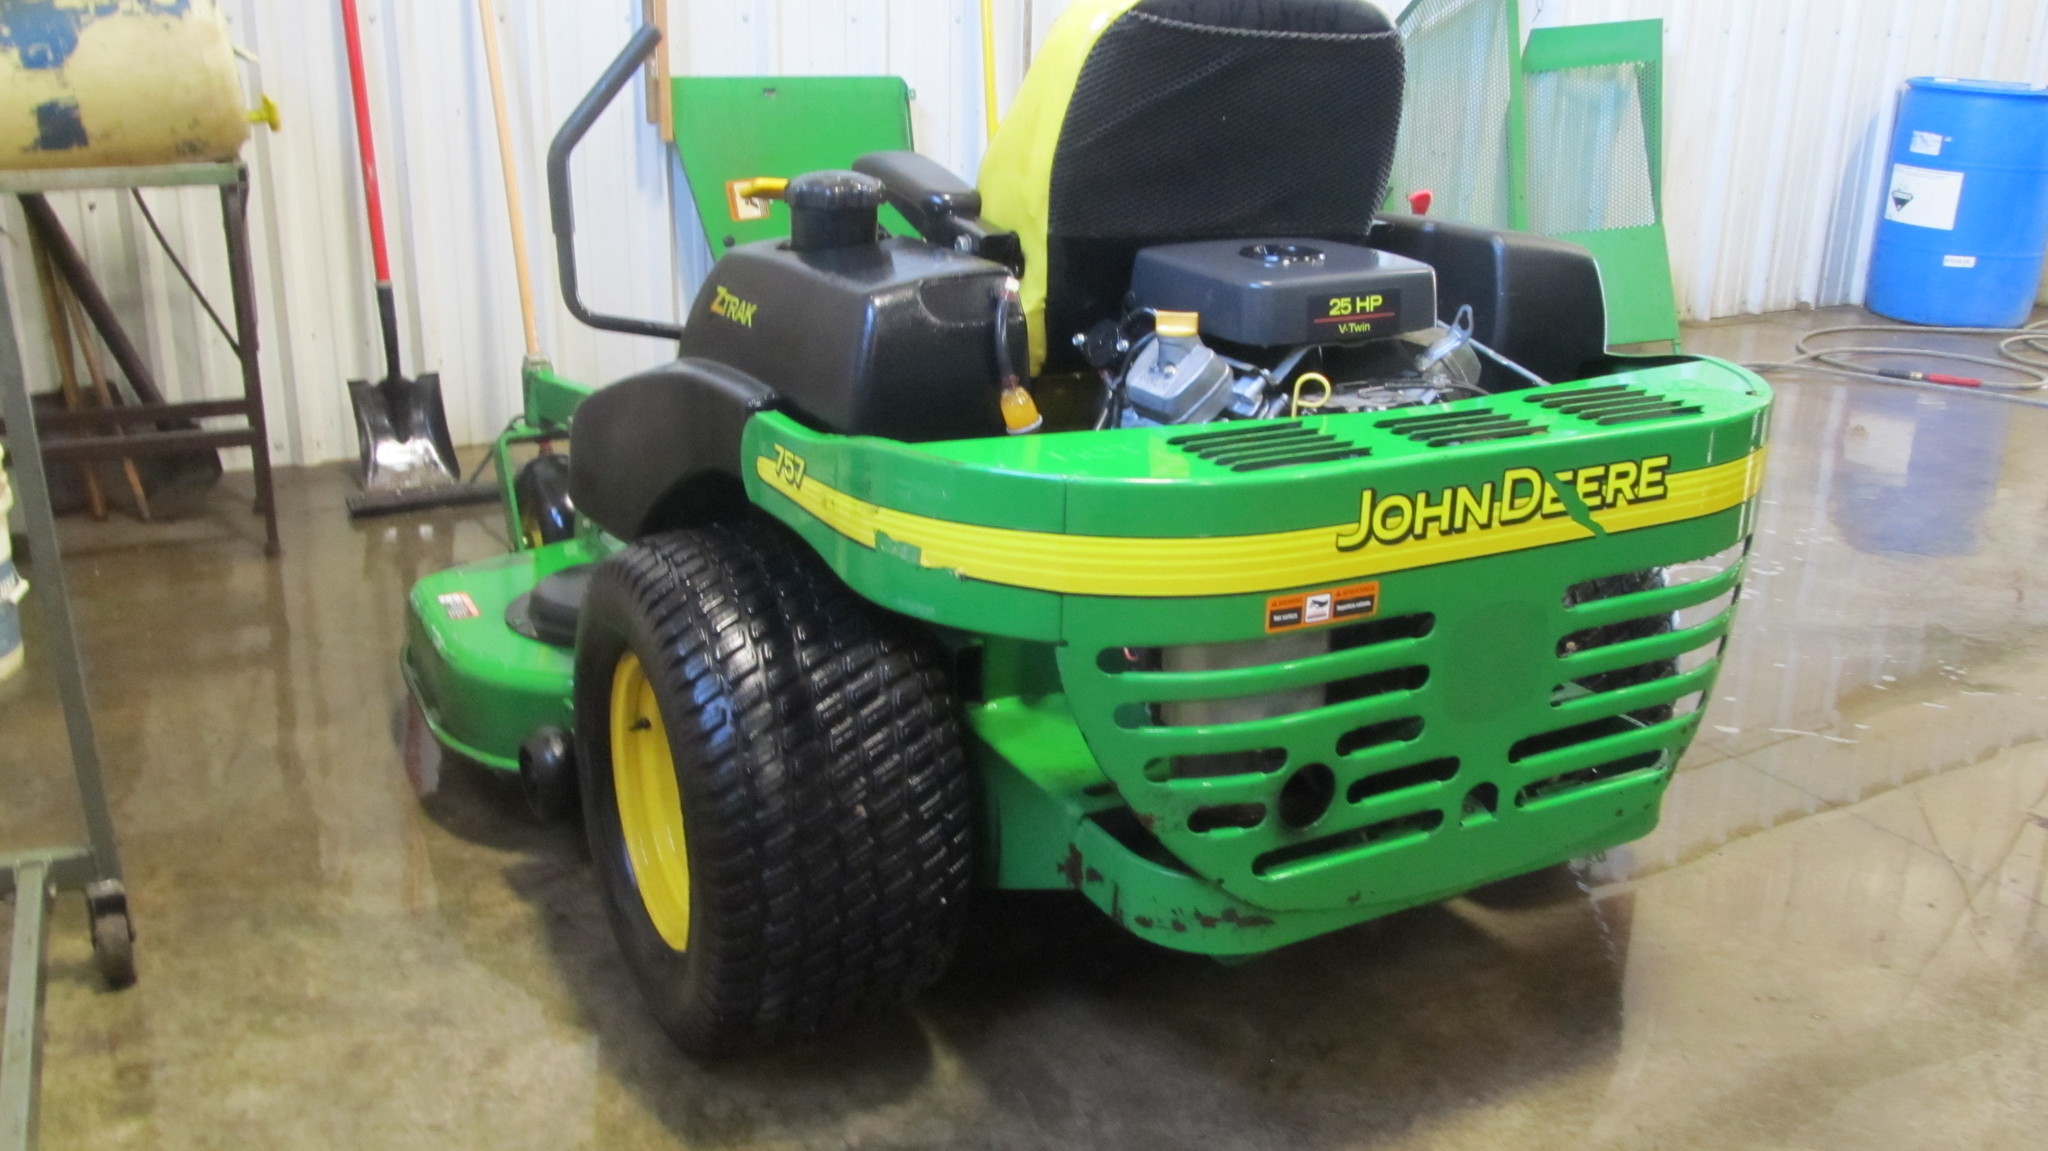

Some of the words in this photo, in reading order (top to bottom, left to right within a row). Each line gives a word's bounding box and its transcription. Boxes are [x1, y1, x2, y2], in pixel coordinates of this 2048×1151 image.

[1329, 297, 1352, 316] 25
[1356, 294, 1383, 313] HP
[773, 442, 806, 490] 757
[1336, 482, 1492, 551] JOHN
